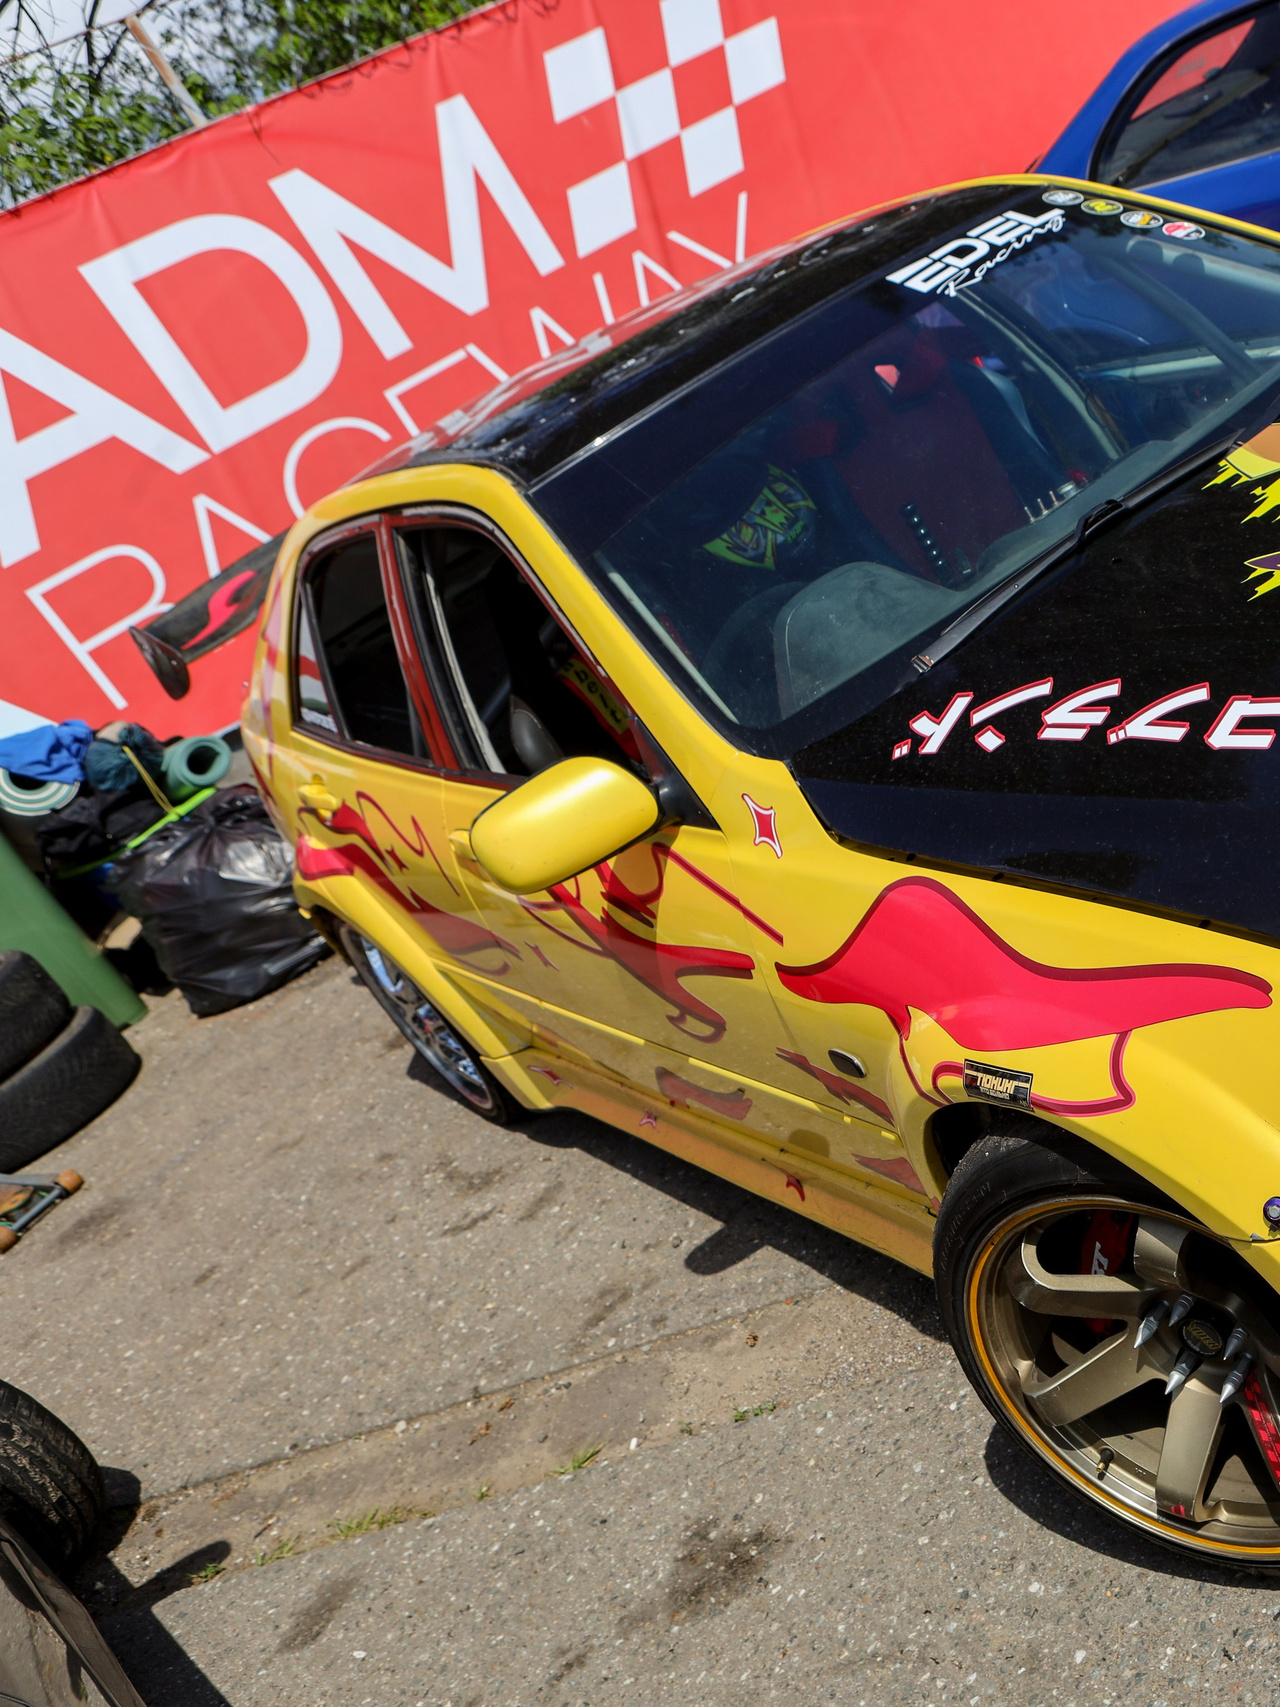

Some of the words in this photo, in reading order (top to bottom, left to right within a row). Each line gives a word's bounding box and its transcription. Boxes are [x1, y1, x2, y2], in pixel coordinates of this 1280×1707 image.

[885, 207, 1066, 294] EDEL
[936, 214, 1067, 297] Racing
[0, 93, 565, 568] ADM
